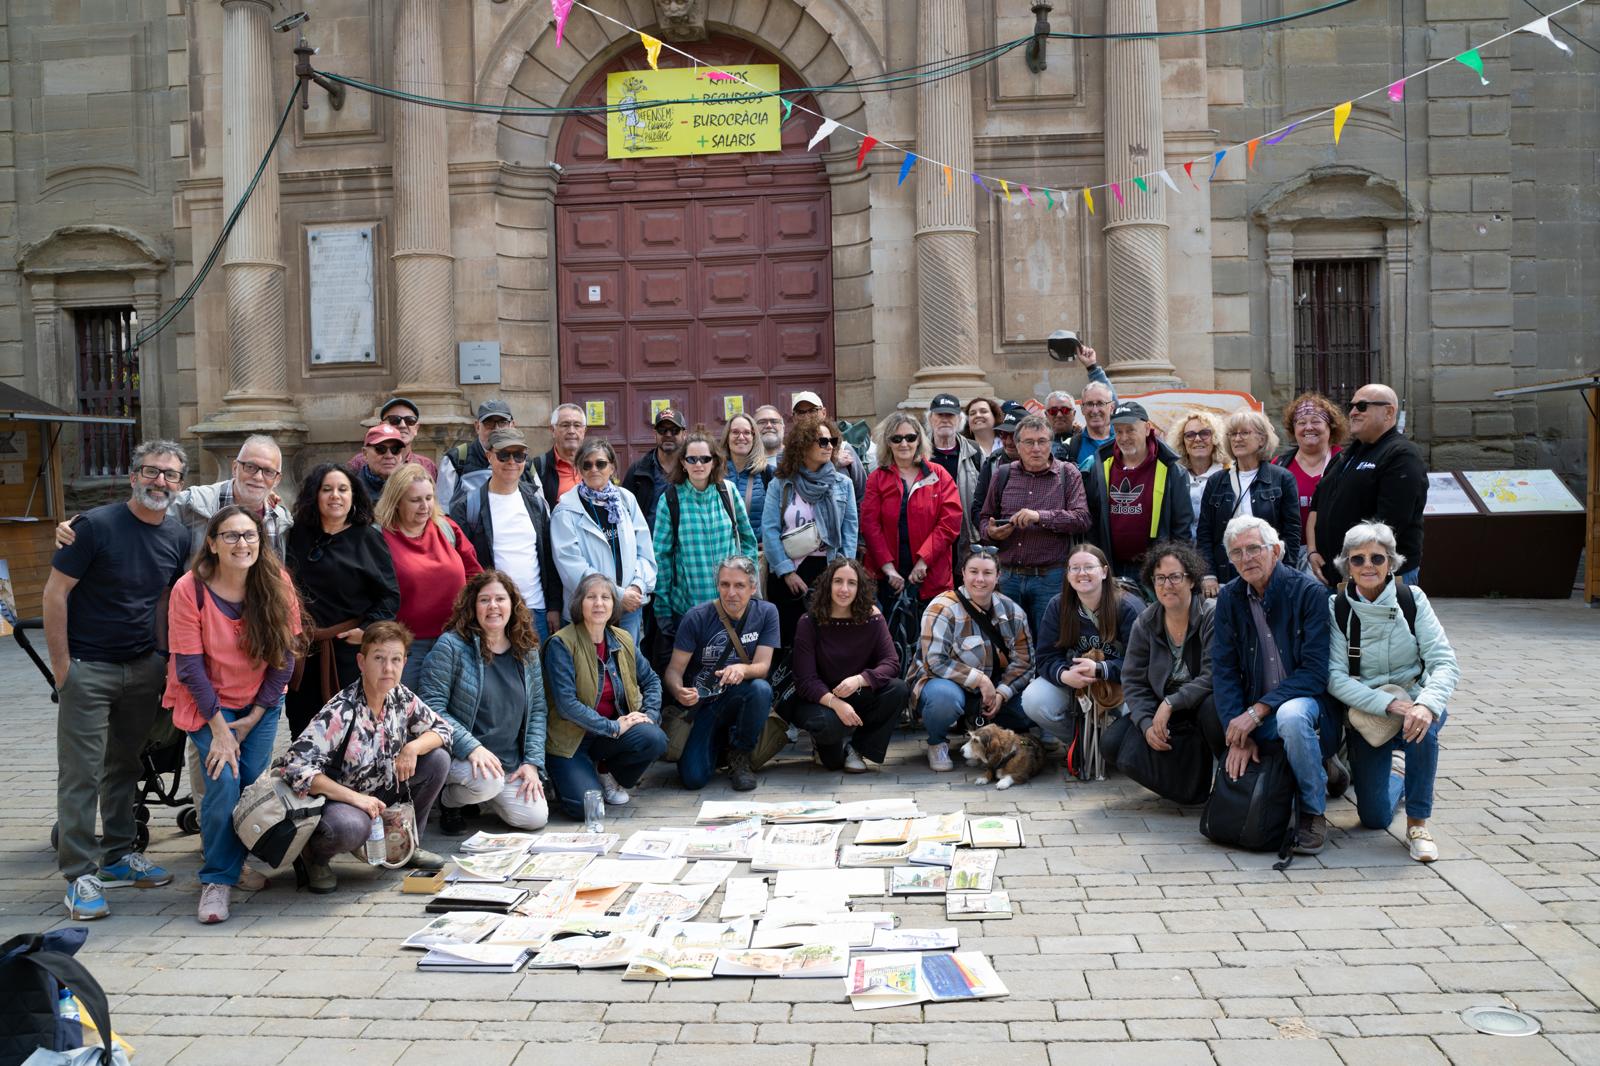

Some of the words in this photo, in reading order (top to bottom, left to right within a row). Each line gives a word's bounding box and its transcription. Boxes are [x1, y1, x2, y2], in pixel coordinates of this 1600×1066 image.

[702, 91, 764, 106] RECURSOS
[693, 110, 769, 128] BUROCRÀCIA
[711, 133, 756, 148] SALARIS
